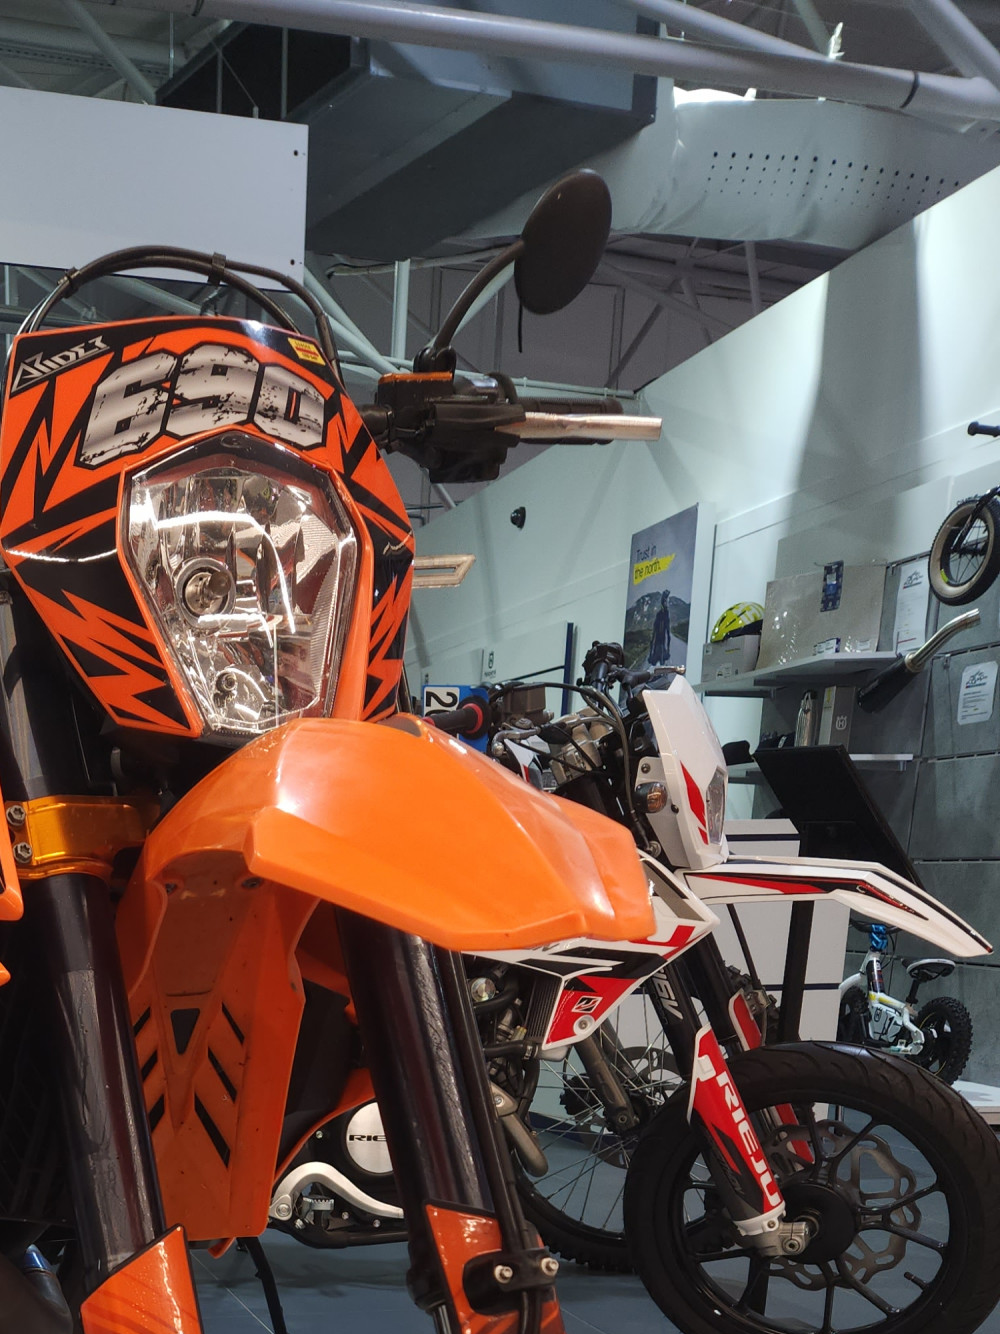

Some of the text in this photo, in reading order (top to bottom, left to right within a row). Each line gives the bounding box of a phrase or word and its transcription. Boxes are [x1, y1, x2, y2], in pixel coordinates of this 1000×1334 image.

[81, 344, 325, 466] 690
[348, 1133, 387, 1142] RIE
[715, 1070, 782, 1208] RIEJU
